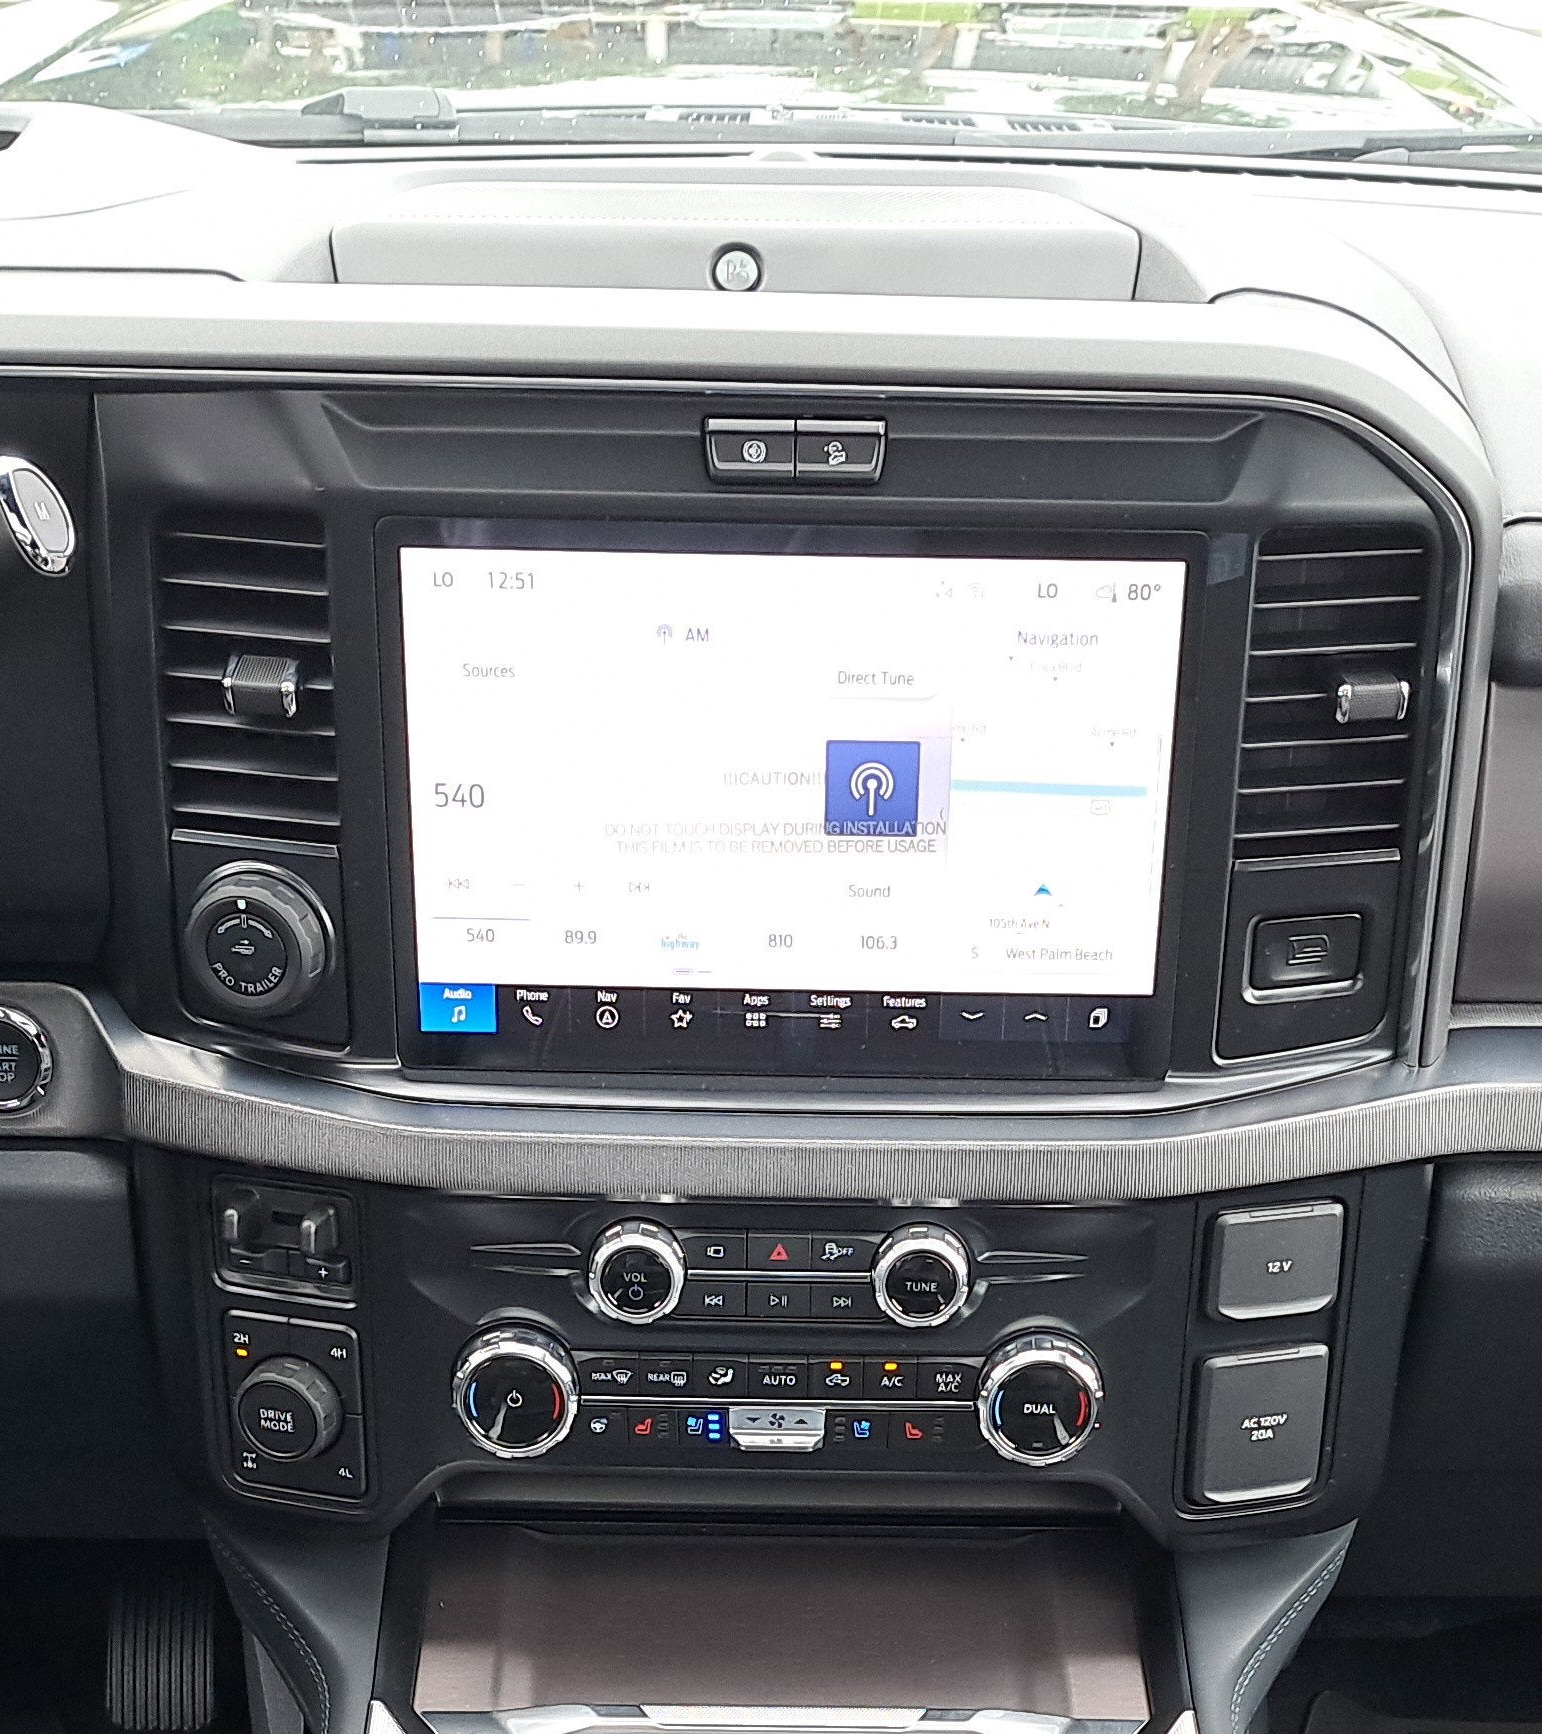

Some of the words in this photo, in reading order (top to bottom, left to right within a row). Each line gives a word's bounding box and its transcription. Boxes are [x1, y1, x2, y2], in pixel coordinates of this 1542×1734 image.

[433, 571, 454, 588] LO
[488, 570, 536, 591] 12:51
[1038, 583, 1058, 599] LO
[1127, 583, 1161, 602] 80°
[685, 627, 710, 643] AM
[1017, 630, 1099, 649] Navigation
[462, 663, 516, 679] Sources
[837, 670, 876, 686] Direct
[880, 671, 915, 687] Tune
[434, 782, 486, 809] 540
[605, 822, 626, 838] DO
[630, 822, 659, 838] NOT
[666, 822, 715, 838] TOUCH
[720, 822, 779, 838] DISPLAY
[783, 821, 840, 837] DURING
[843, 820, 947, 837] INSTALLATION
[616, 840, 649, 855] THIS
[652, 840, 686, 855] FILM
[690, 840, 703, 855] IS
[706, 840, 726, 855] TO
[751, 840, 823, 855] REMOVED
[827, 839, 884, 854] BEFORE
[888, 839, 937, 854] USAGE
[848, 884, 891, 899] Sound
[466, 928, 495, 944] 540
[564, 930, 597, 945] 89.9
[768, 933, 793, 949] 810
[860, 935, 897, 950] 106.3
[1006, 947, 1036, 960] West
[1040, 947, 1072, 960] Palm
[1075, 947, 1113, 961] Beach
[212, 962, 235, 987] PRO
[239, 966, 283, 993] TRAILER
[443, 988, 472, 1000] Audio
[516, 989, 549, 1002] Phone
[597, 990, 618, 1003] Nav
[672, 992, 691, 1004] Fav
[743, 993, 769, 1008] Apps
[810, 994, 851, 1009] Settings
[883, 995, 926, 1008] Features
[1267, 1262, 1280, 1273] 12
[1281, 1261, 1293, 1272] V
[623, 1272, 647, 1283] VOL
[905, 1281, 938, 1293] TUNE
[233, 1332, 249, 1345] 2H
[330, 1347, 347, 1359] 4H
[591, 1372, 612, 1381] MAX
[647, 1372, 670, 1382] REAR
[762, 1375, 796, 1386] AUTO
[880, 1376, 904, 1388] A/C
[936, 1373, 962, 1383] MAX
[938, 1382, 959, 1393] A/C
[259, 1407, 293, 1422] DRIVE
[1023, 1403, 1056, 1414] DUAL
[260, 1419, 296, 1433] MODE
[1241, 1416, 1259, 1429] AC
[1259, 1413, 1288, 1427] 120V
[1251, 1429, 1274, 1441] 20A
[338, 1467, 353, 1479] 4L
